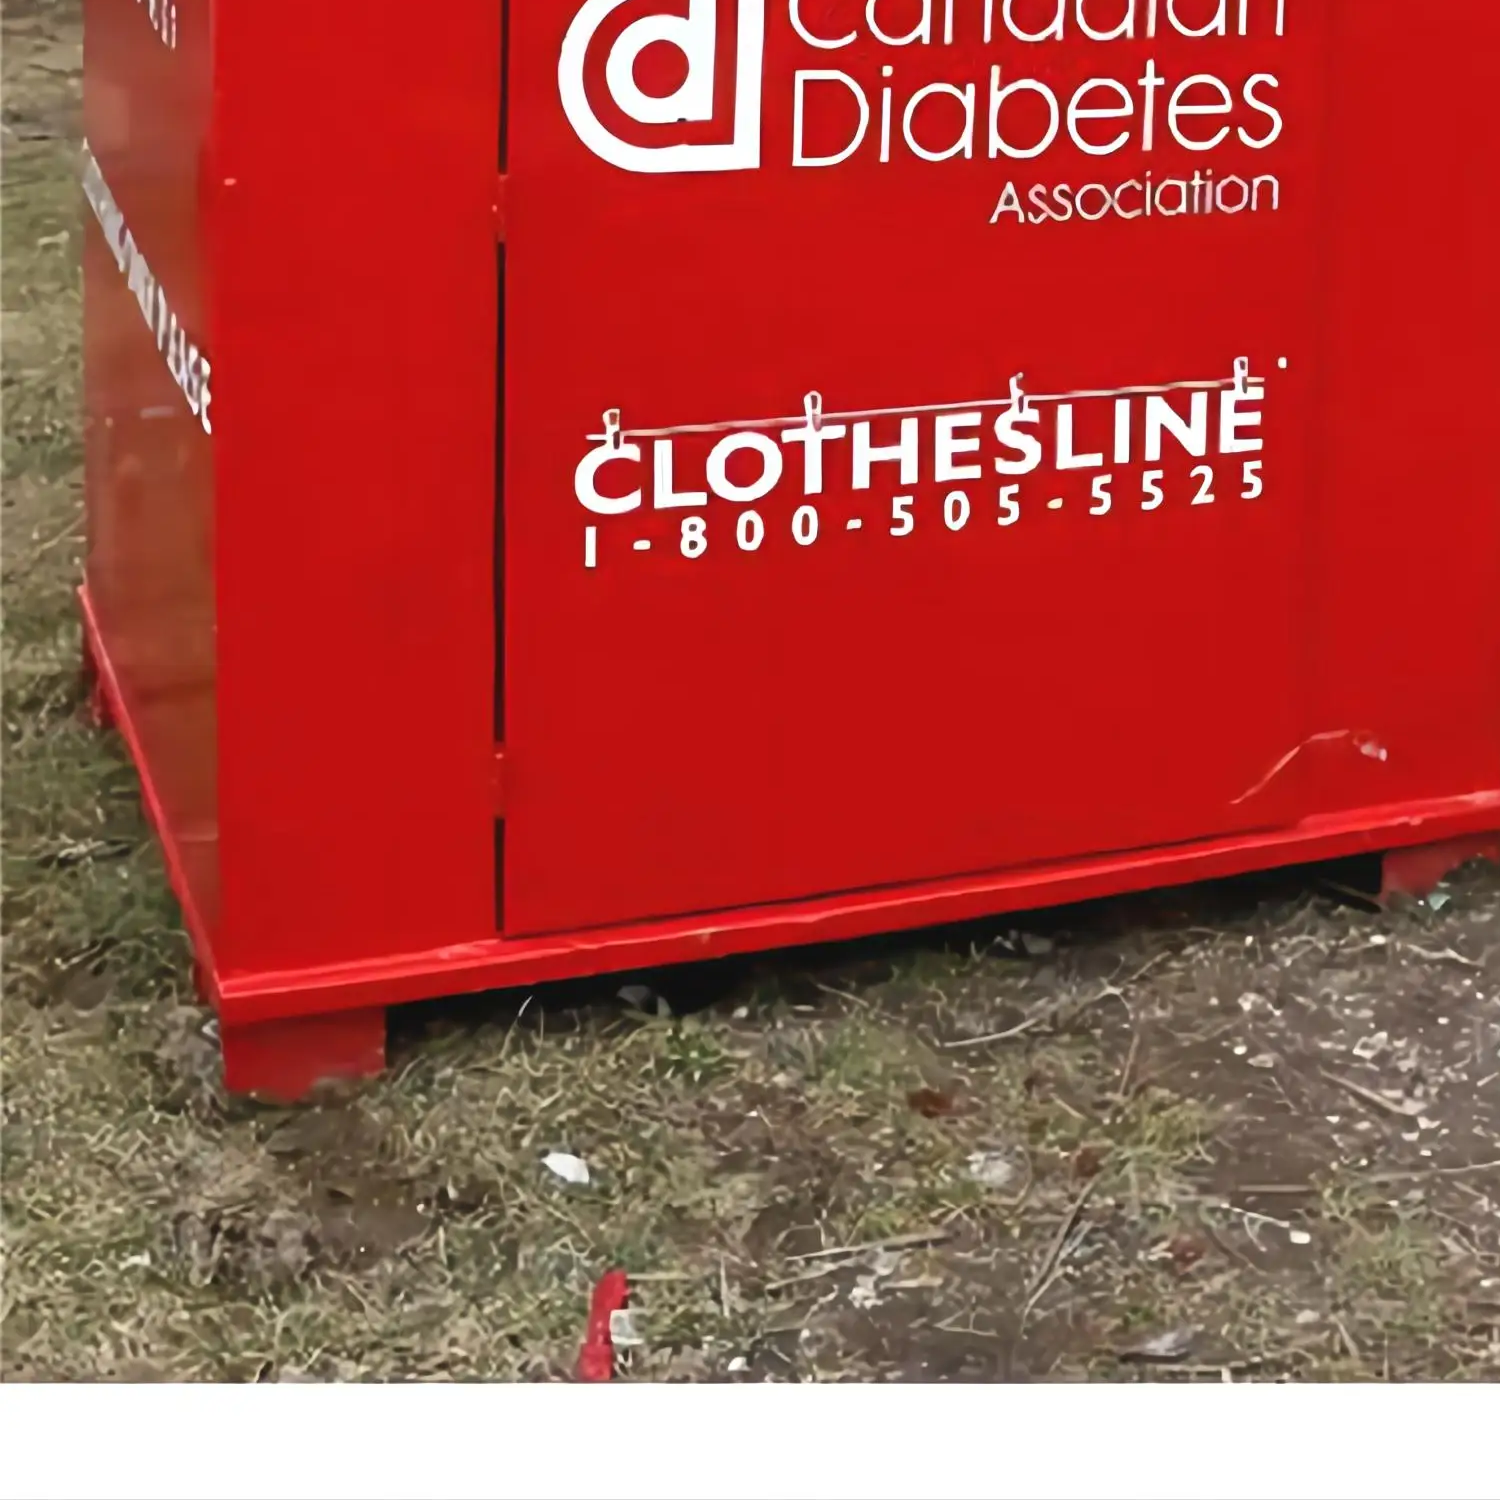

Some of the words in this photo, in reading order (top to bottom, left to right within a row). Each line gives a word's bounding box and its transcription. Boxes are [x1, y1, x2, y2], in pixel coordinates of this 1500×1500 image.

[792, 59, 1283, 167] Diabetes
[989, 169, 1279, 223] Association
[575, 380, 1263, 513] CLOTHESLINE
